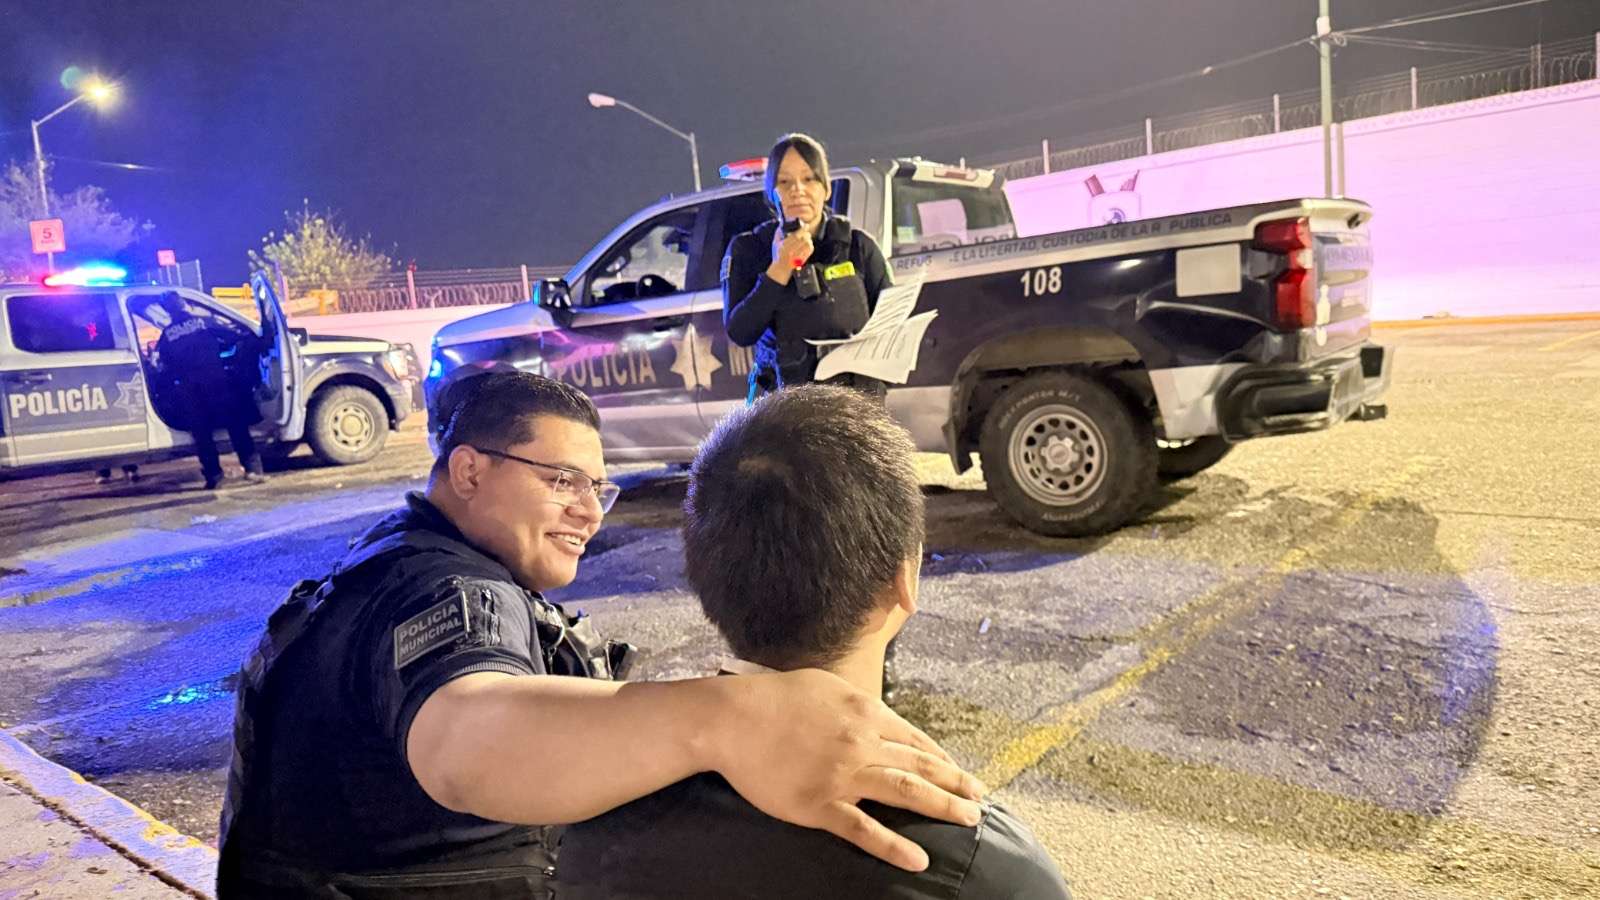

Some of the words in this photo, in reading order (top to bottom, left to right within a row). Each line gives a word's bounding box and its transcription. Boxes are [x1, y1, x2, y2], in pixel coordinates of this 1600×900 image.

[42, 228, 52, 239] 5
[1041, 229, 1107, 249] CUSTODIA
[1110, 225, 1129, 240] DE
[1131, 222, 1149, 237] LA
[1020, 266, 1063, 296] 108
[9, 384, 108, 418] POLICÍA
[400, 603, 459, 641] POLICIA
[400, 617, 463, 656] MUNICIPAL
